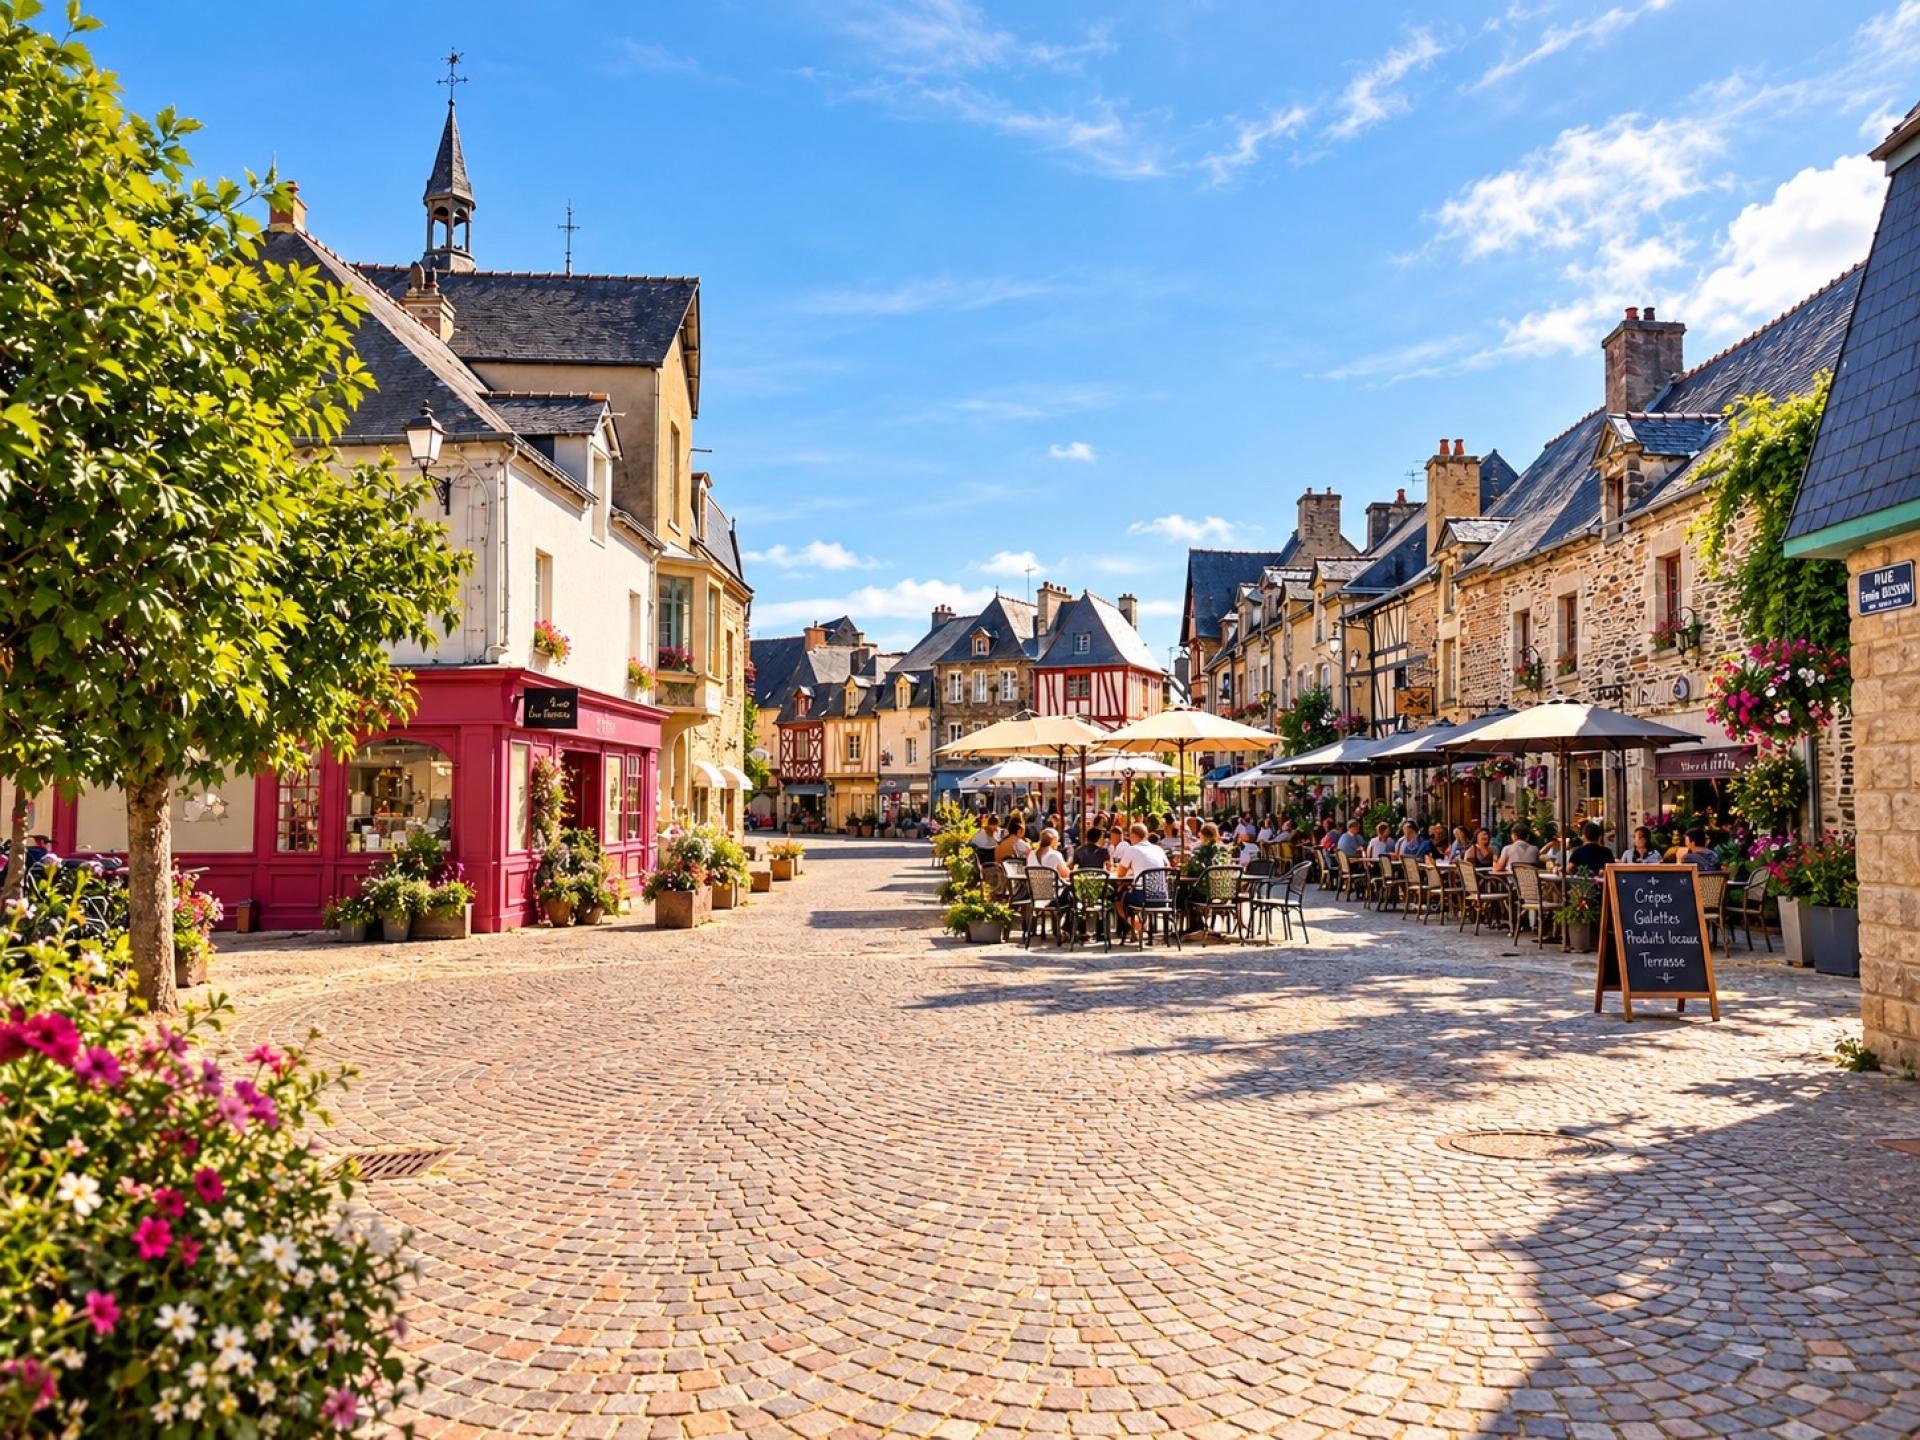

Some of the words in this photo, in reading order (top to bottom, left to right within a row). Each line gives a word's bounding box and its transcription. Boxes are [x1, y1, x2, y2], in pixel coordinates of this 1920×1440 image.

[1874, 570, 1894, 586] RUE
[1634, 910, 1680, 925] Galettes
[1625, 929, 1665, 945] Produits
[1668, 930, 1699, 944] locaux
[1639, 952, 1686, 967] Terrasse
